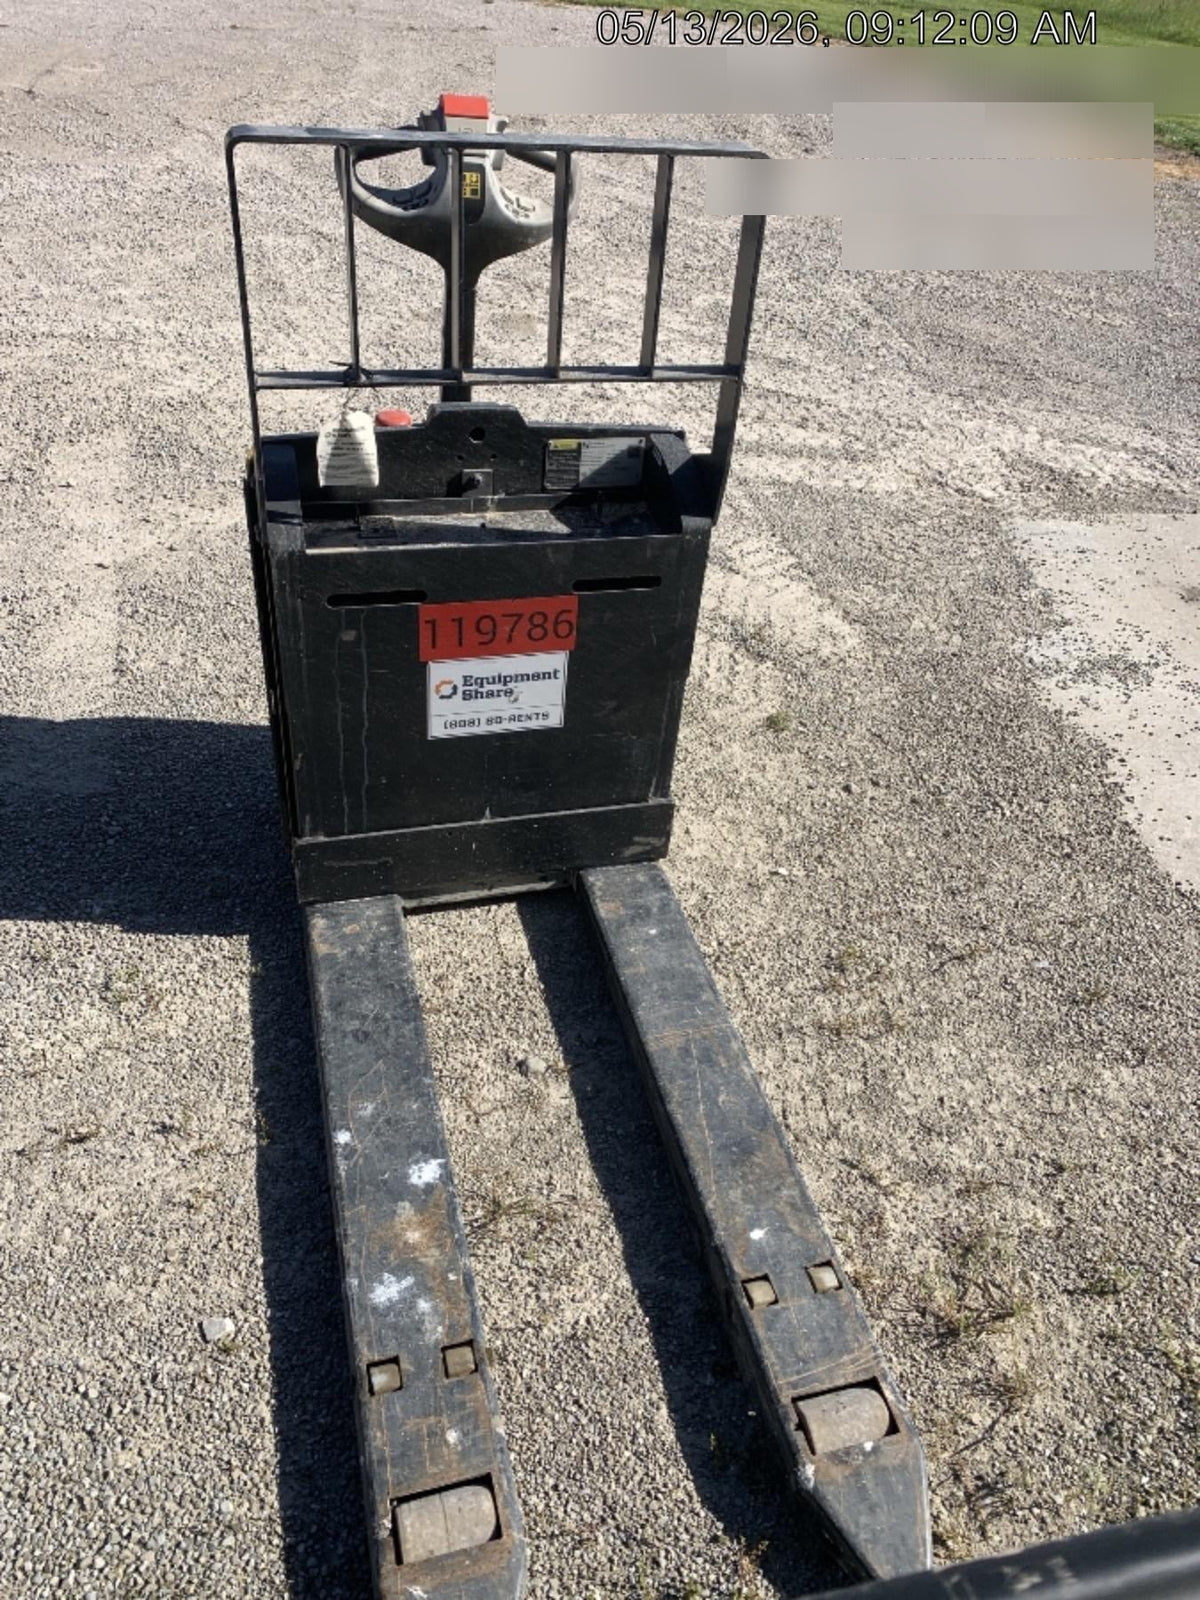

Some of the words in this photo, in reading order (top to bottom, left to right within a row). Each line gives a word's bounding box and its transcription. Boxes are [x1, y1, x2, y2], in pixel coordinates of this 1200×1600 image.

[424, 609, 575, 649] 119786
[462, 668, 560, 688] Equipment
[462, 687, 514, 701] Share
